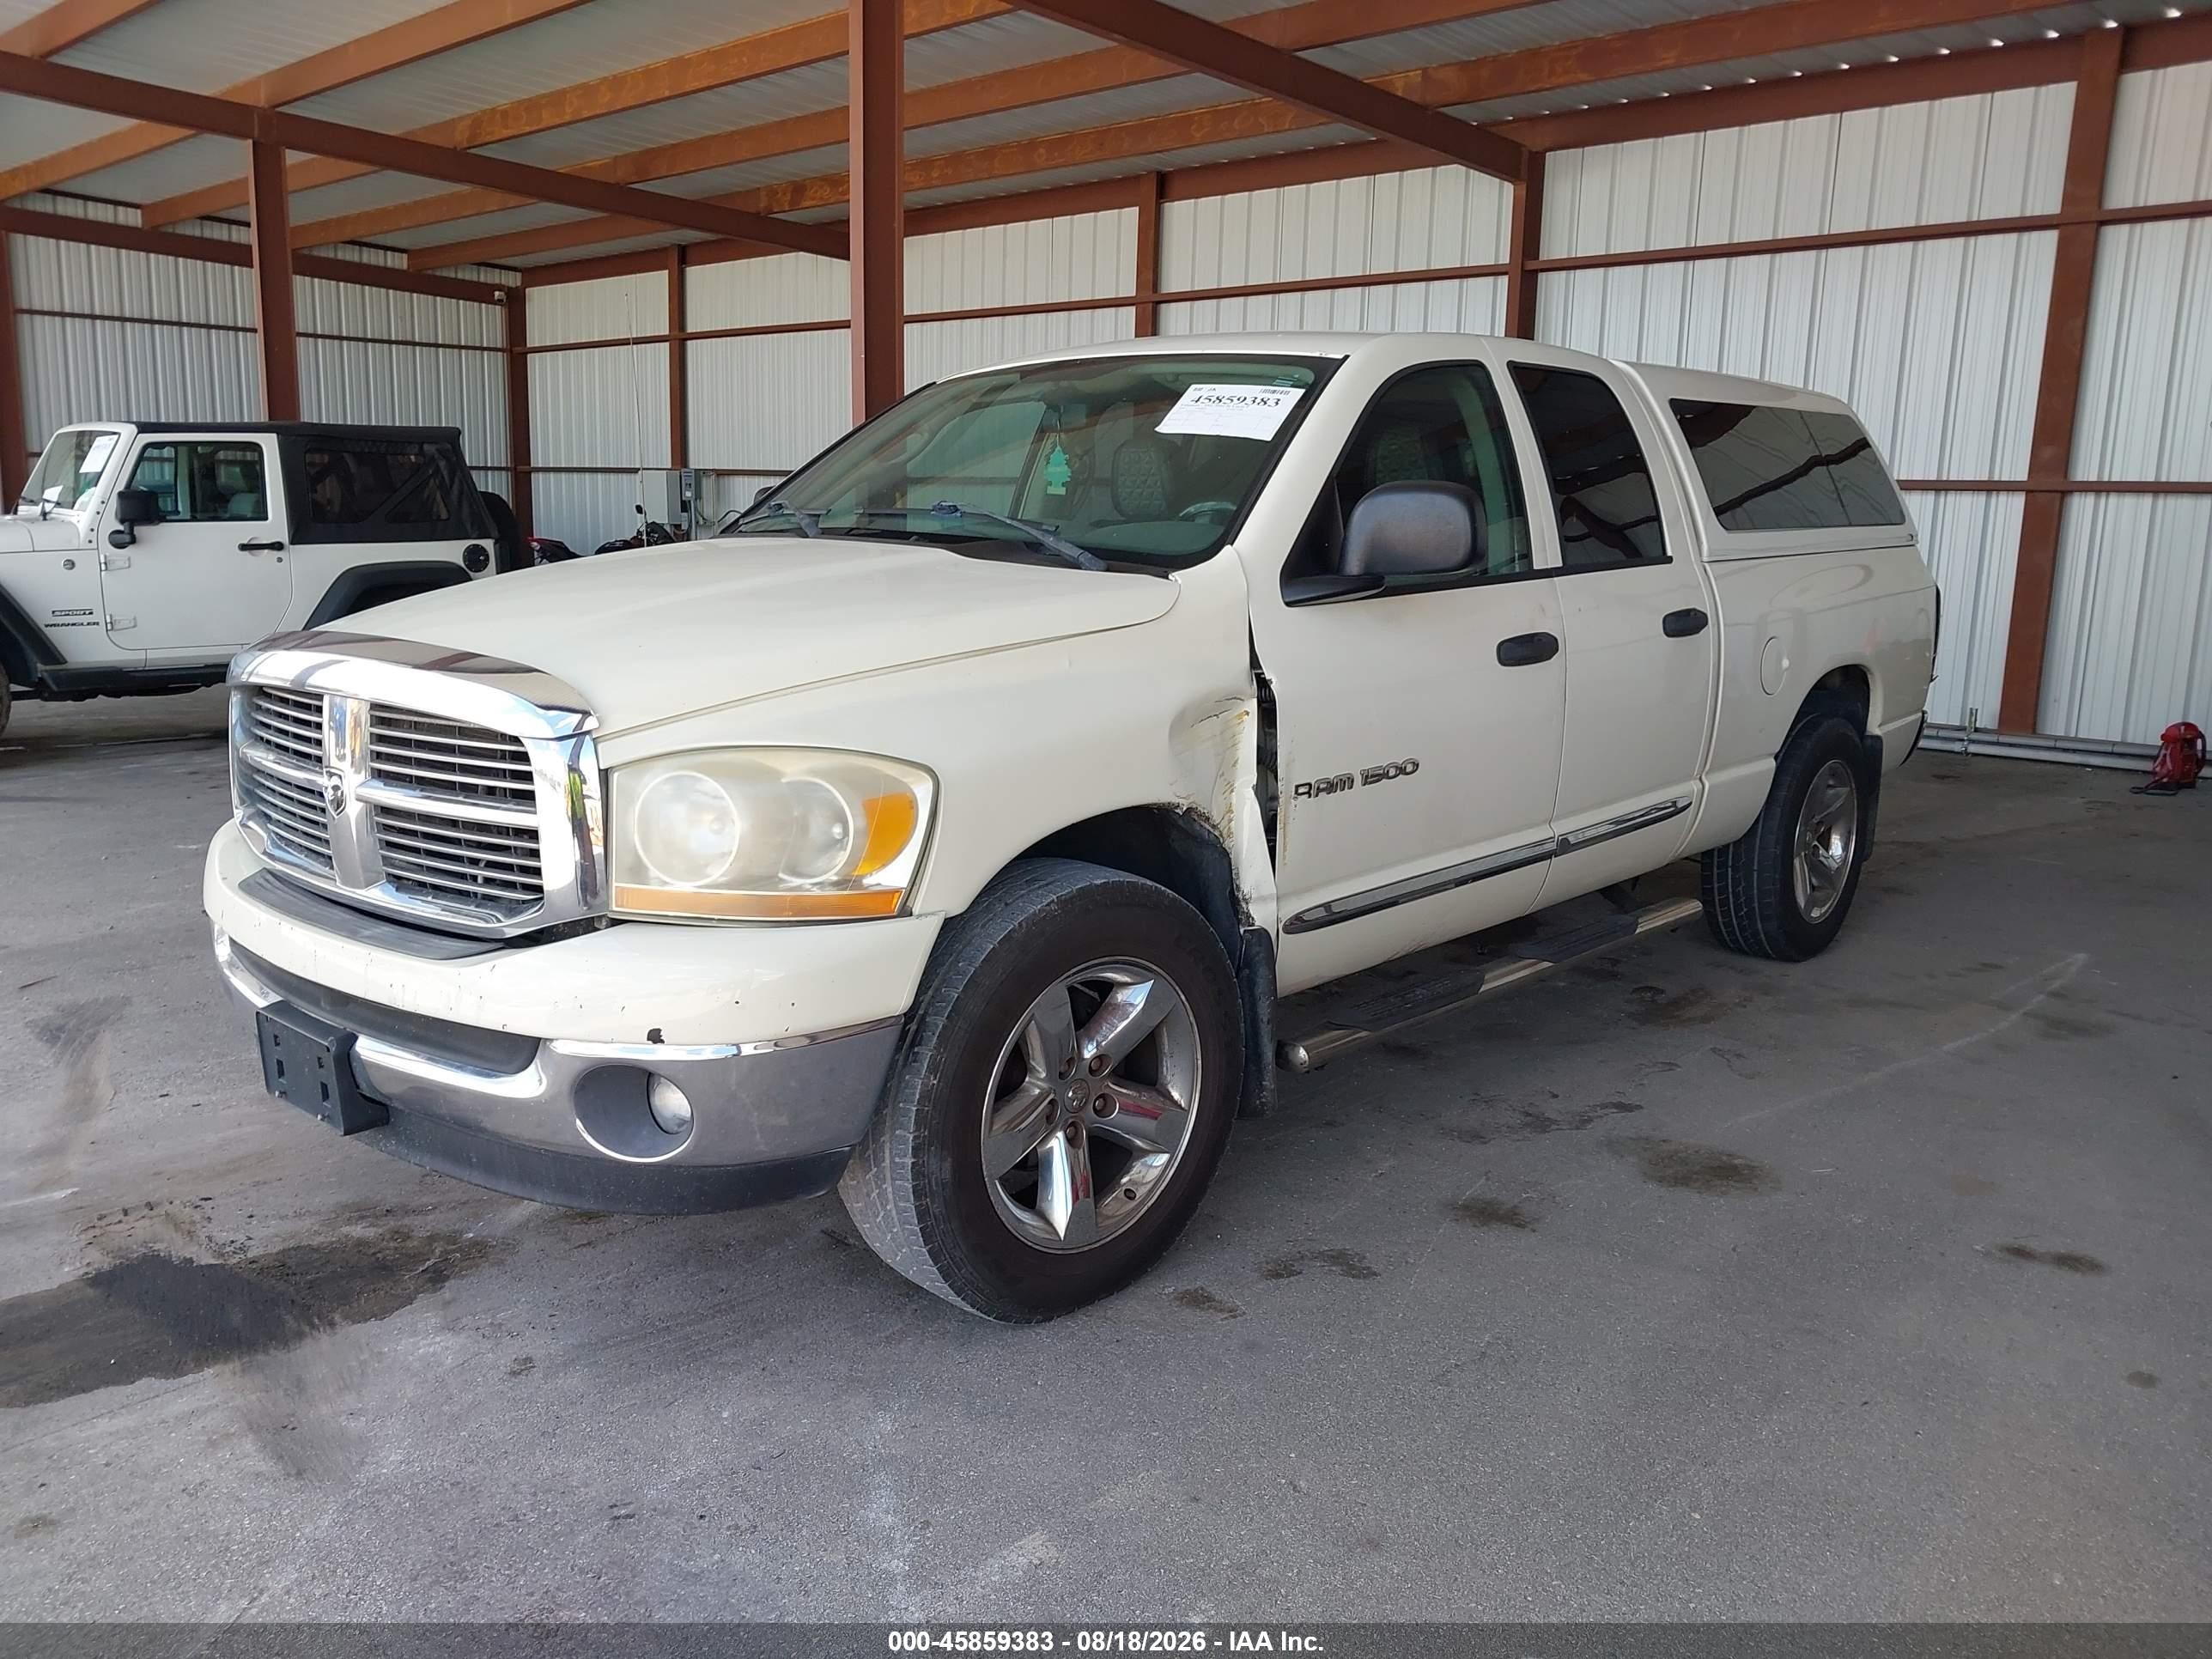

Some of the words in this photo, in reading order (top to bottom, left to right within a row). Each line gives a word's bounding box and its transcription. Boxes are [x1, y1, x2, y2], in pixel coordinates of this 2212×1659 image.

[1190, 394, 1281, 408] 45859383
[1294, 772, 1355, 799] RAM
[1359, 757, 1420, 787] 1500
